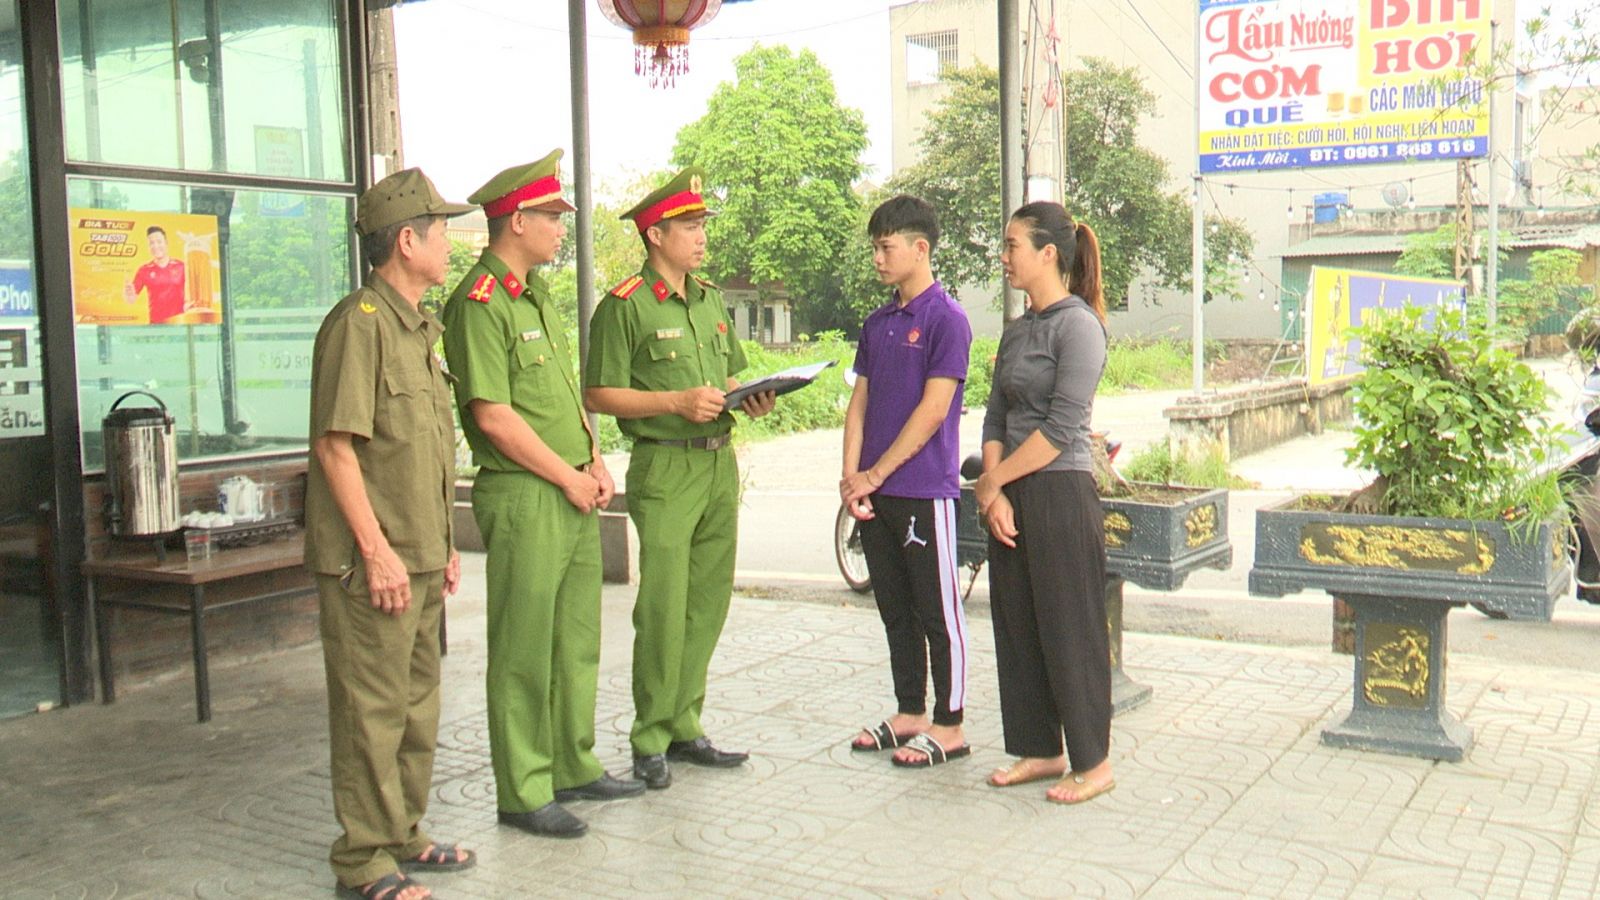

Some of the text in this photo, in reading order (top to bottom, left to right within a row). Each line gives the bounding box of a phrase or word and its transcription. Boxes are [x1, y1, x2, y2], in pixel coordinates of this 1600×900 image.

[1205, 6, 1354, 64] Lẩu Nướng
[1373, 31, 1476, 74] HƠI
[1209, 64, 1322, 103] CƠM
[1370, 83, 1398, 111] CÁC
[1225, 100, 1304, 128] QUÊ
[1309, 148, 1339, 162] ĐT:
[79, 243, 138, 257] GOLD
